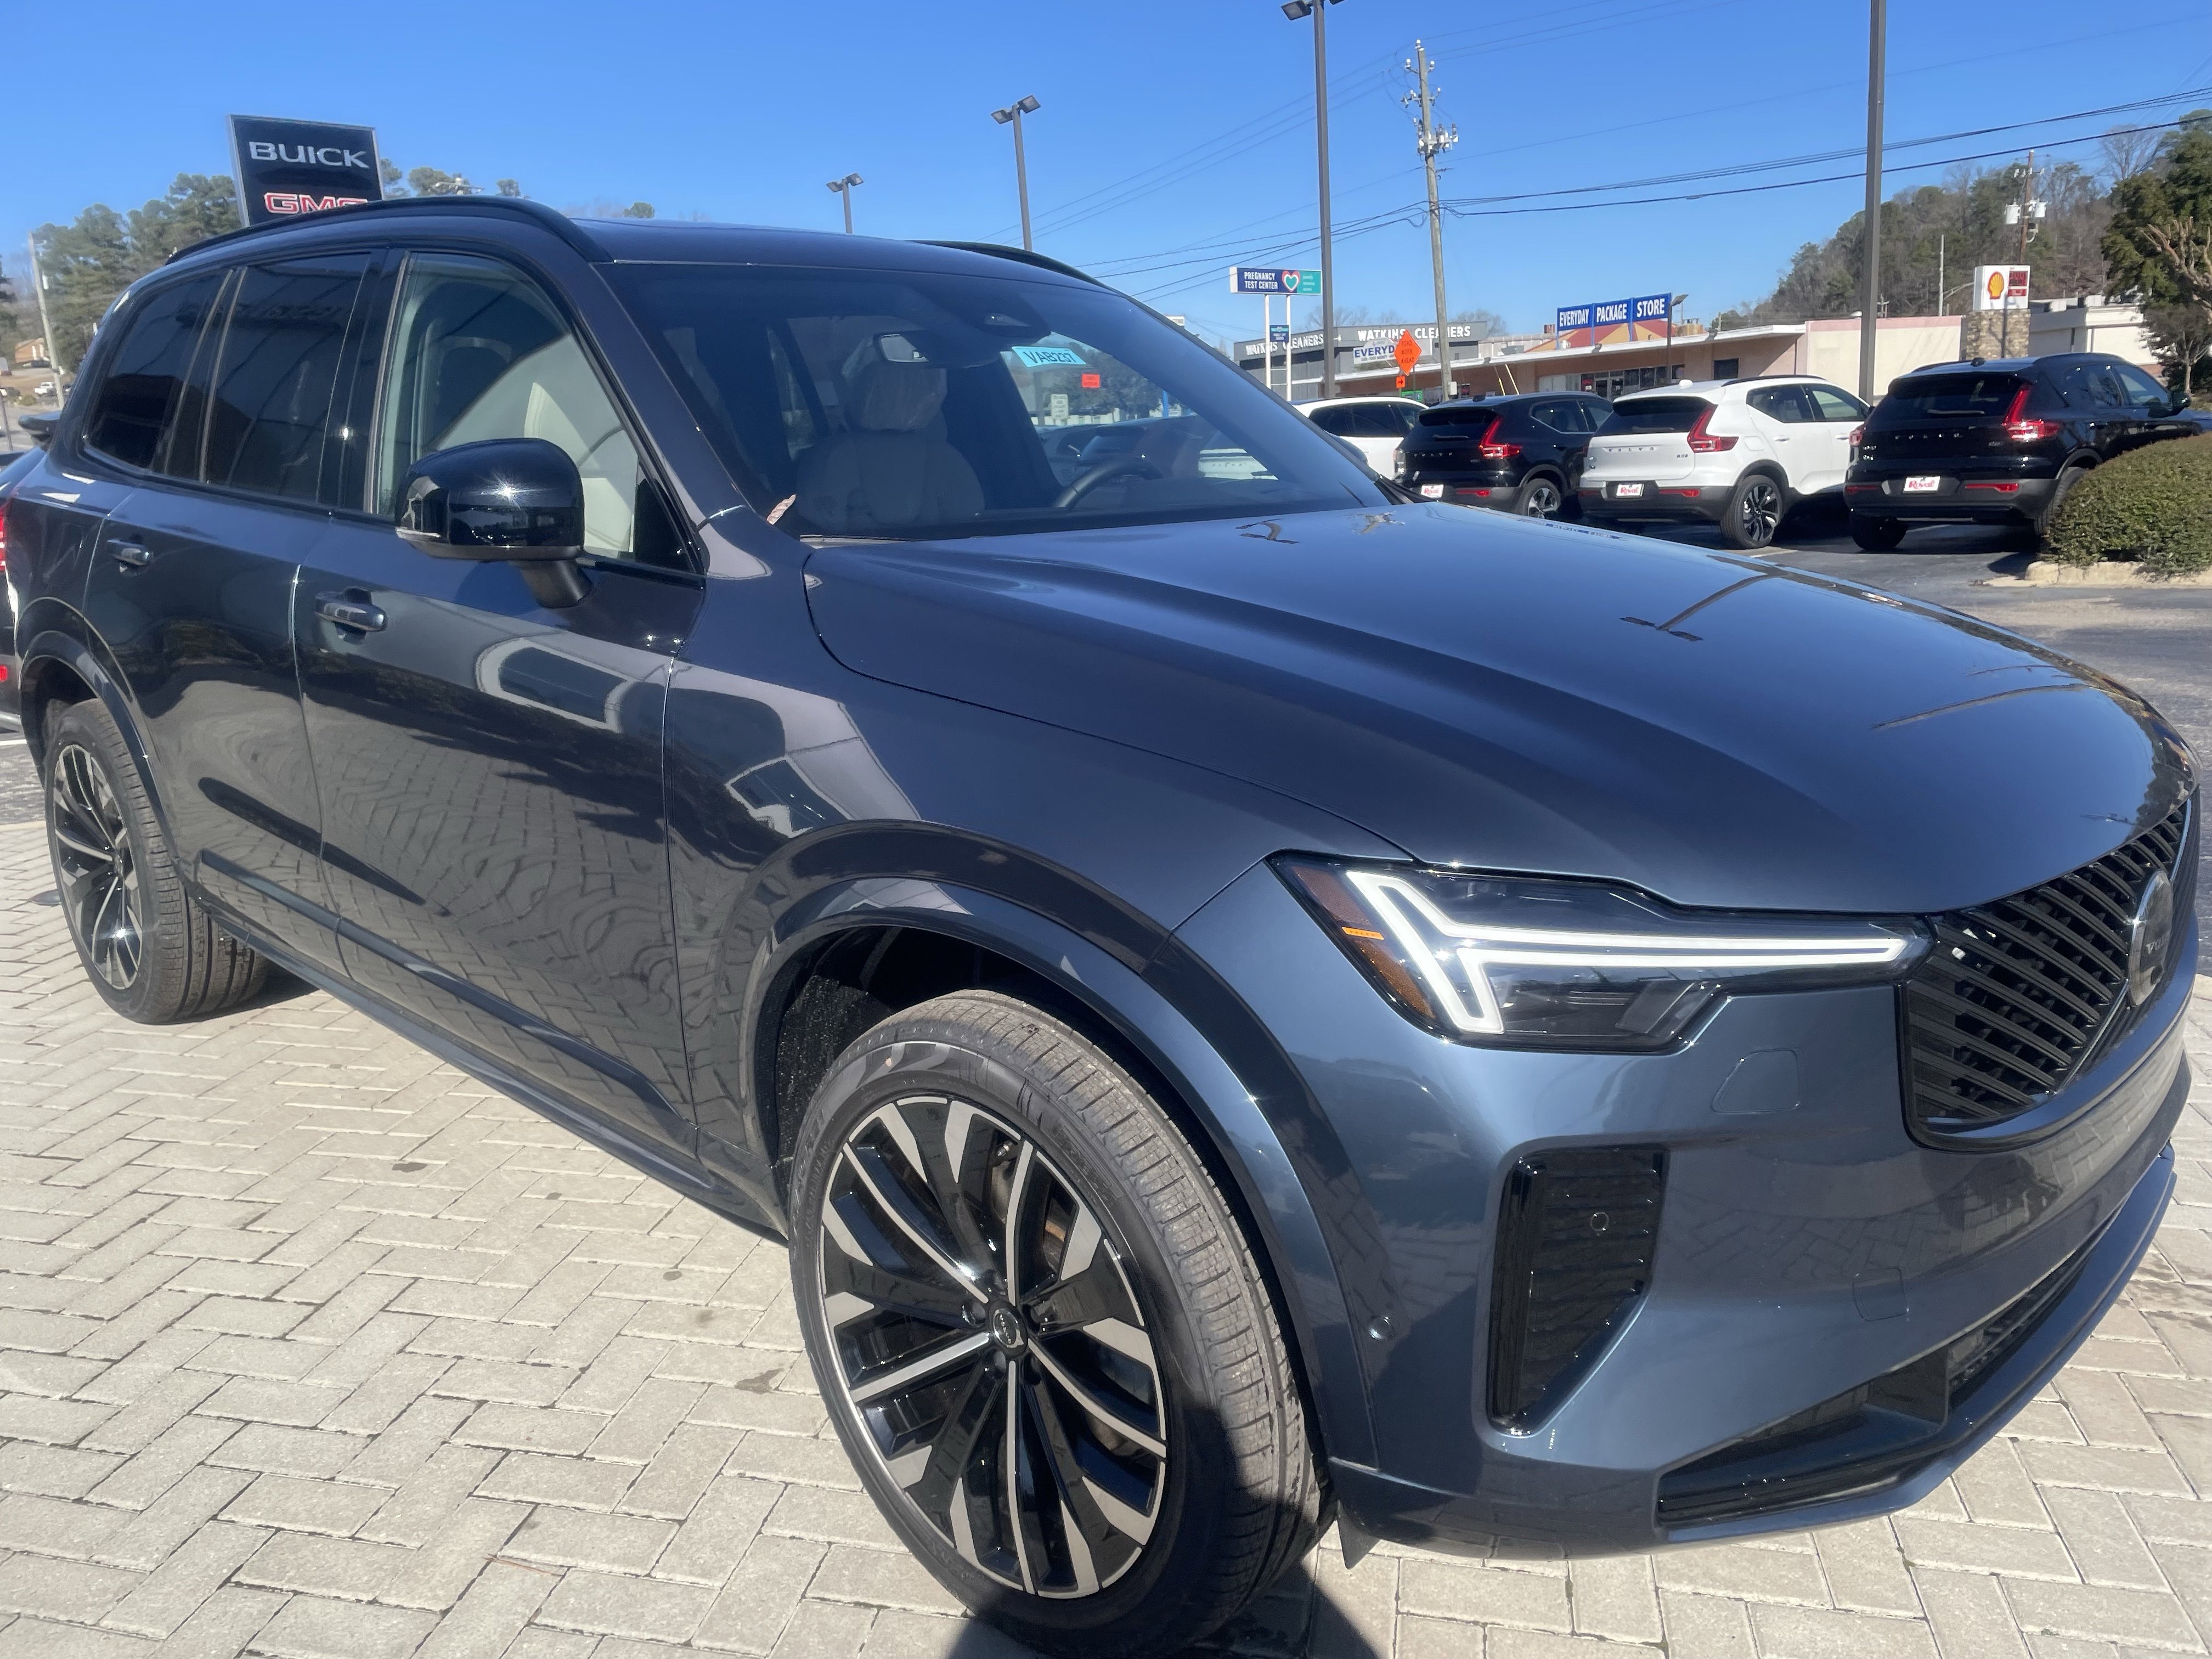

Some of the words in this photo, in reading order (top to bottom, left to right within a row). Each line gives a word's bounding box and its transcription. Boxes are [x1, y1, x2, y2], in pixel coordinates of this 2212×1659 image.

[249, 141, 369, 168] BUICK
[1244, 271, 1276, 280] PREGNANCY
[1244, 280, 1257, 289] TEST
[1259, 281, 1278, 290] CENTER
[1559, 308, 1589, 328] EVERYDAY
[1596, 302, 1627, 321] PACKAGE
[1636, 297, 1665, 318] STORE
[1023, 351, 1077, 364] VAB237
[1354, 345, 1395, 358] EVERYD
[1908, 480, 1936, 489] Royal
